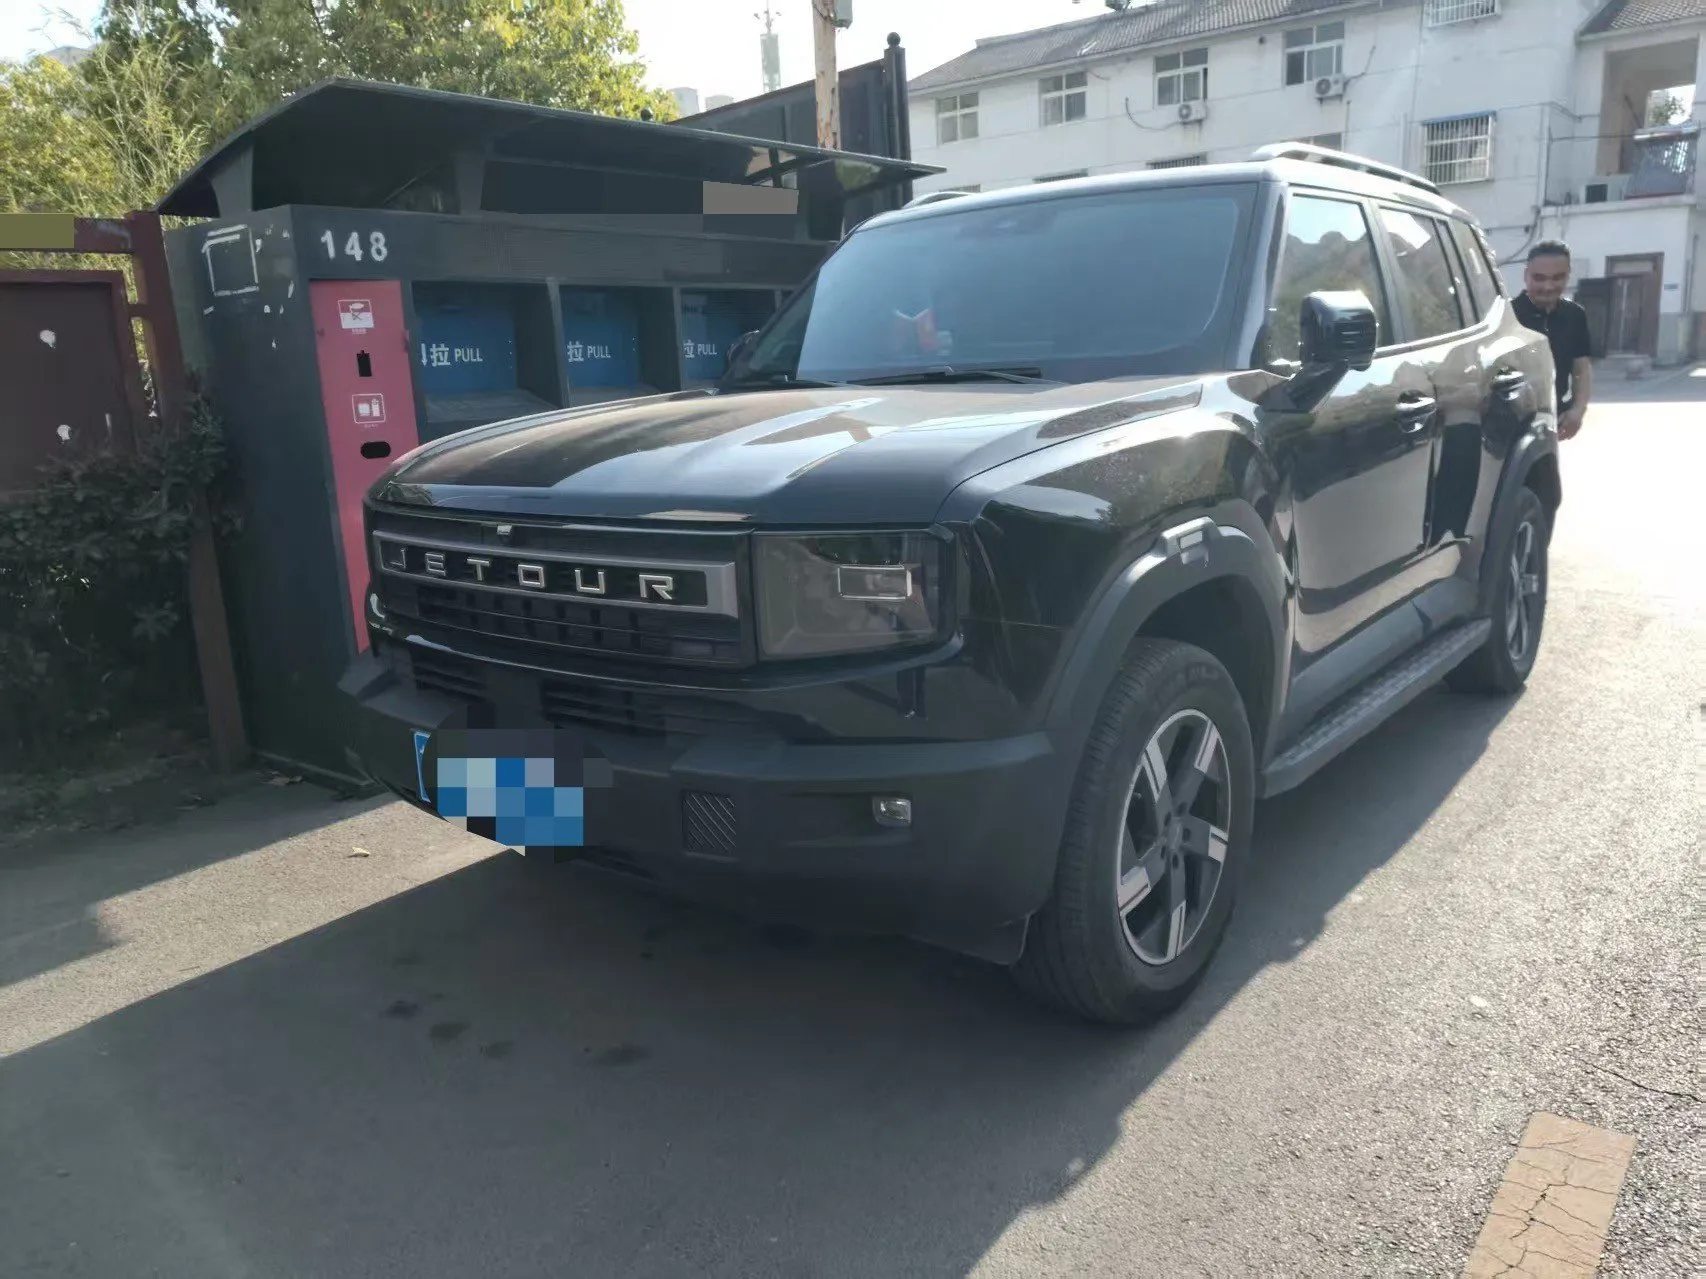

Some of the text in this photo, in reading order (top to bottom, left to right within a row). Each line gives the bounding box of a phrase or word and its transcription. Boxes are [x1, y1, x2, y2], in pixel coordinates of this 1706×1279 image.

[321, 230, 388, 261] 148
[430, 343, 484, 367] 拉 PULL
[567, 341, 611, 362] 拉 PULL
[697, 344, 718, 356] PULL
[388, 548, 674, 600] JETOUR
